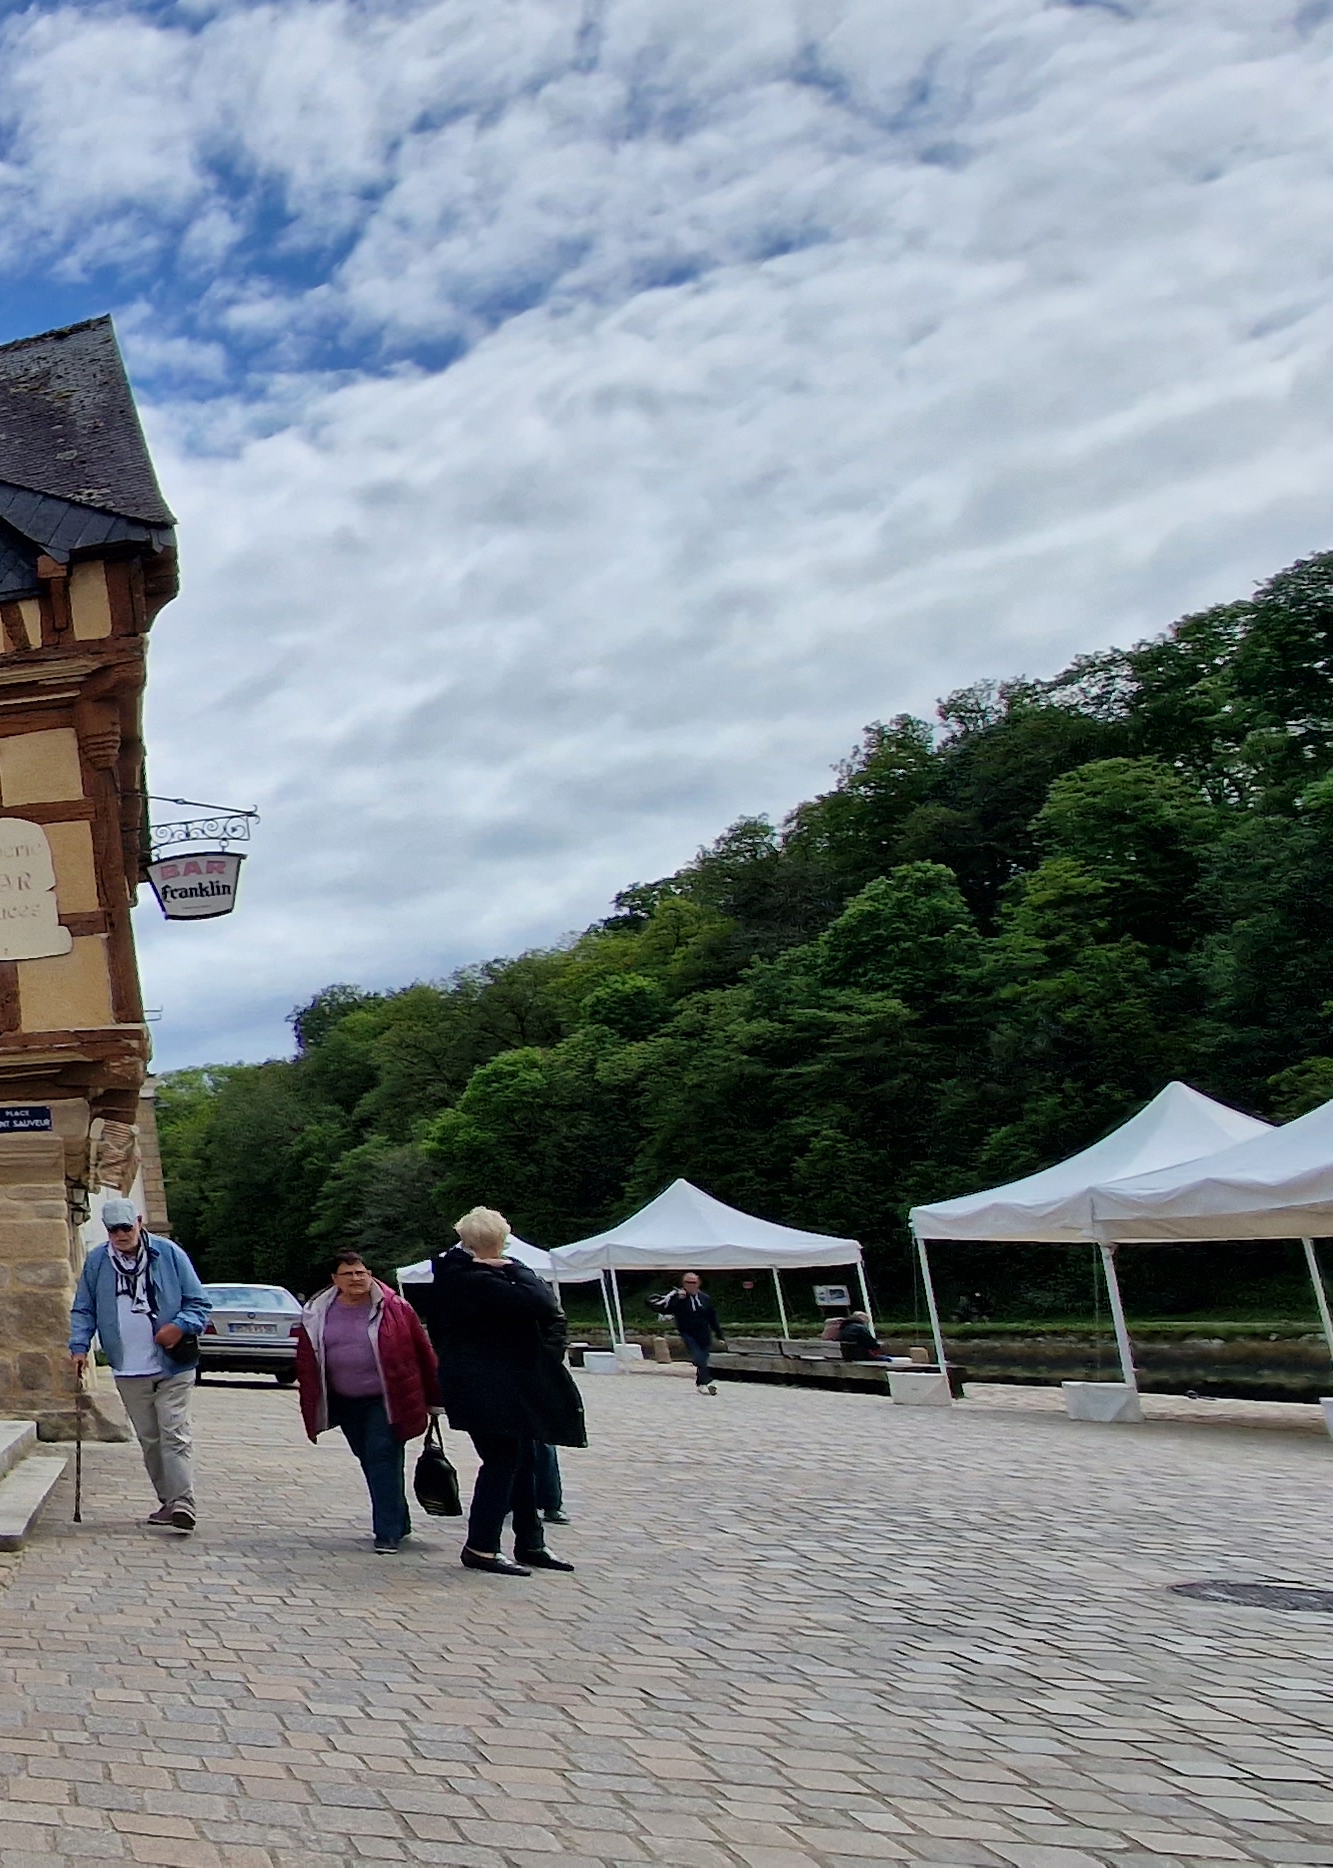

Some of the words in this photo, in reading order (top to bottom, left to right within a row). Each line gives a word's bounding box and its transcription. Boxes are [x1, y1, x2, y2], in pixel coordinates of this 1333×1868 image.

[160, 861, 228, 880] BAR
[4, 1109, 31, 1117] PLACE
[12, 1118, 51, 1128] SAUVEUR
